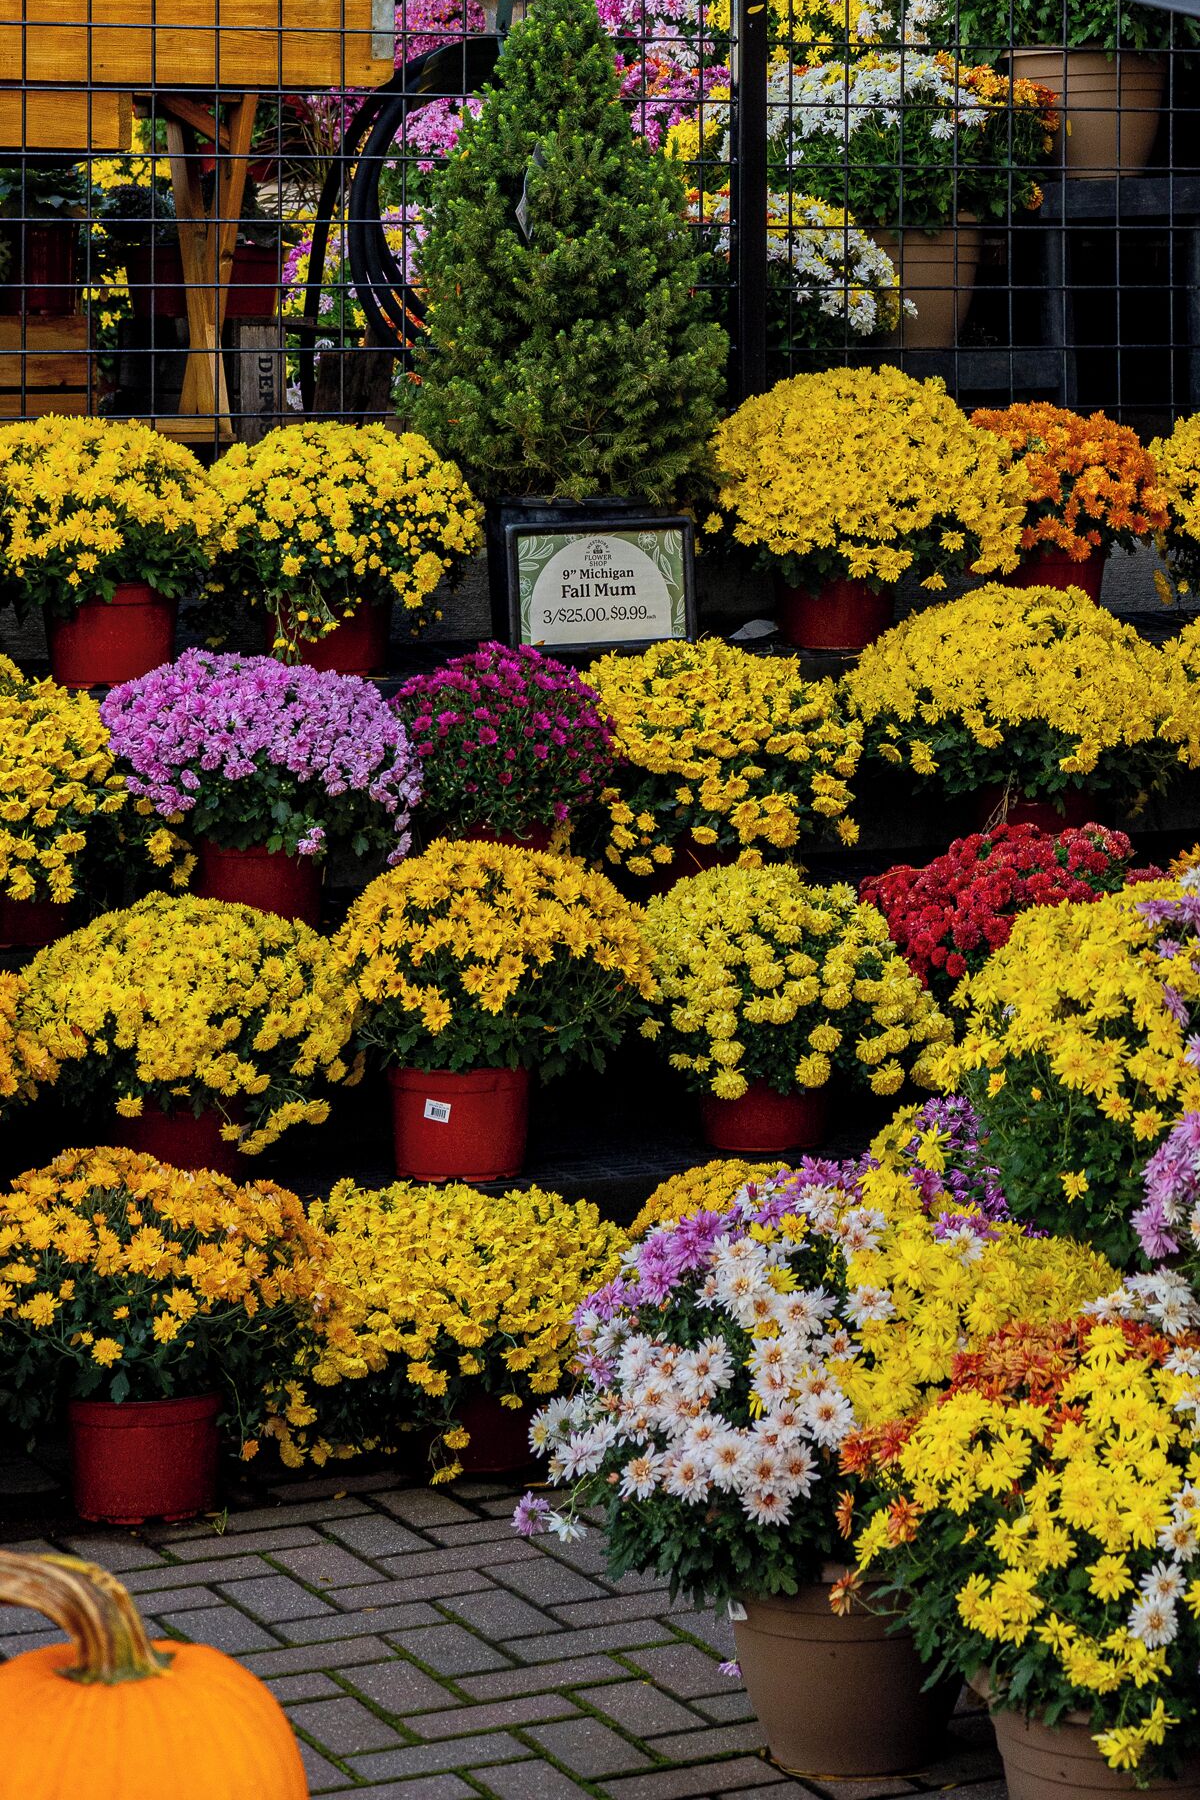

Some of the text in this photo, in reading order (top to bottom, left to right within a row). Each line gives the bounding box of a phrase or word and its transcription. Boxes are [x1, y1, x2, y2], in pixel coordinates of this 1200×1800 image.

[579, 568, 634, 581] Michigan
[561, 583, 636, 598] Fall Mum
[543, 607, 606, 625] 3/$25.00
[610, 605, 647, 620] $9.99
